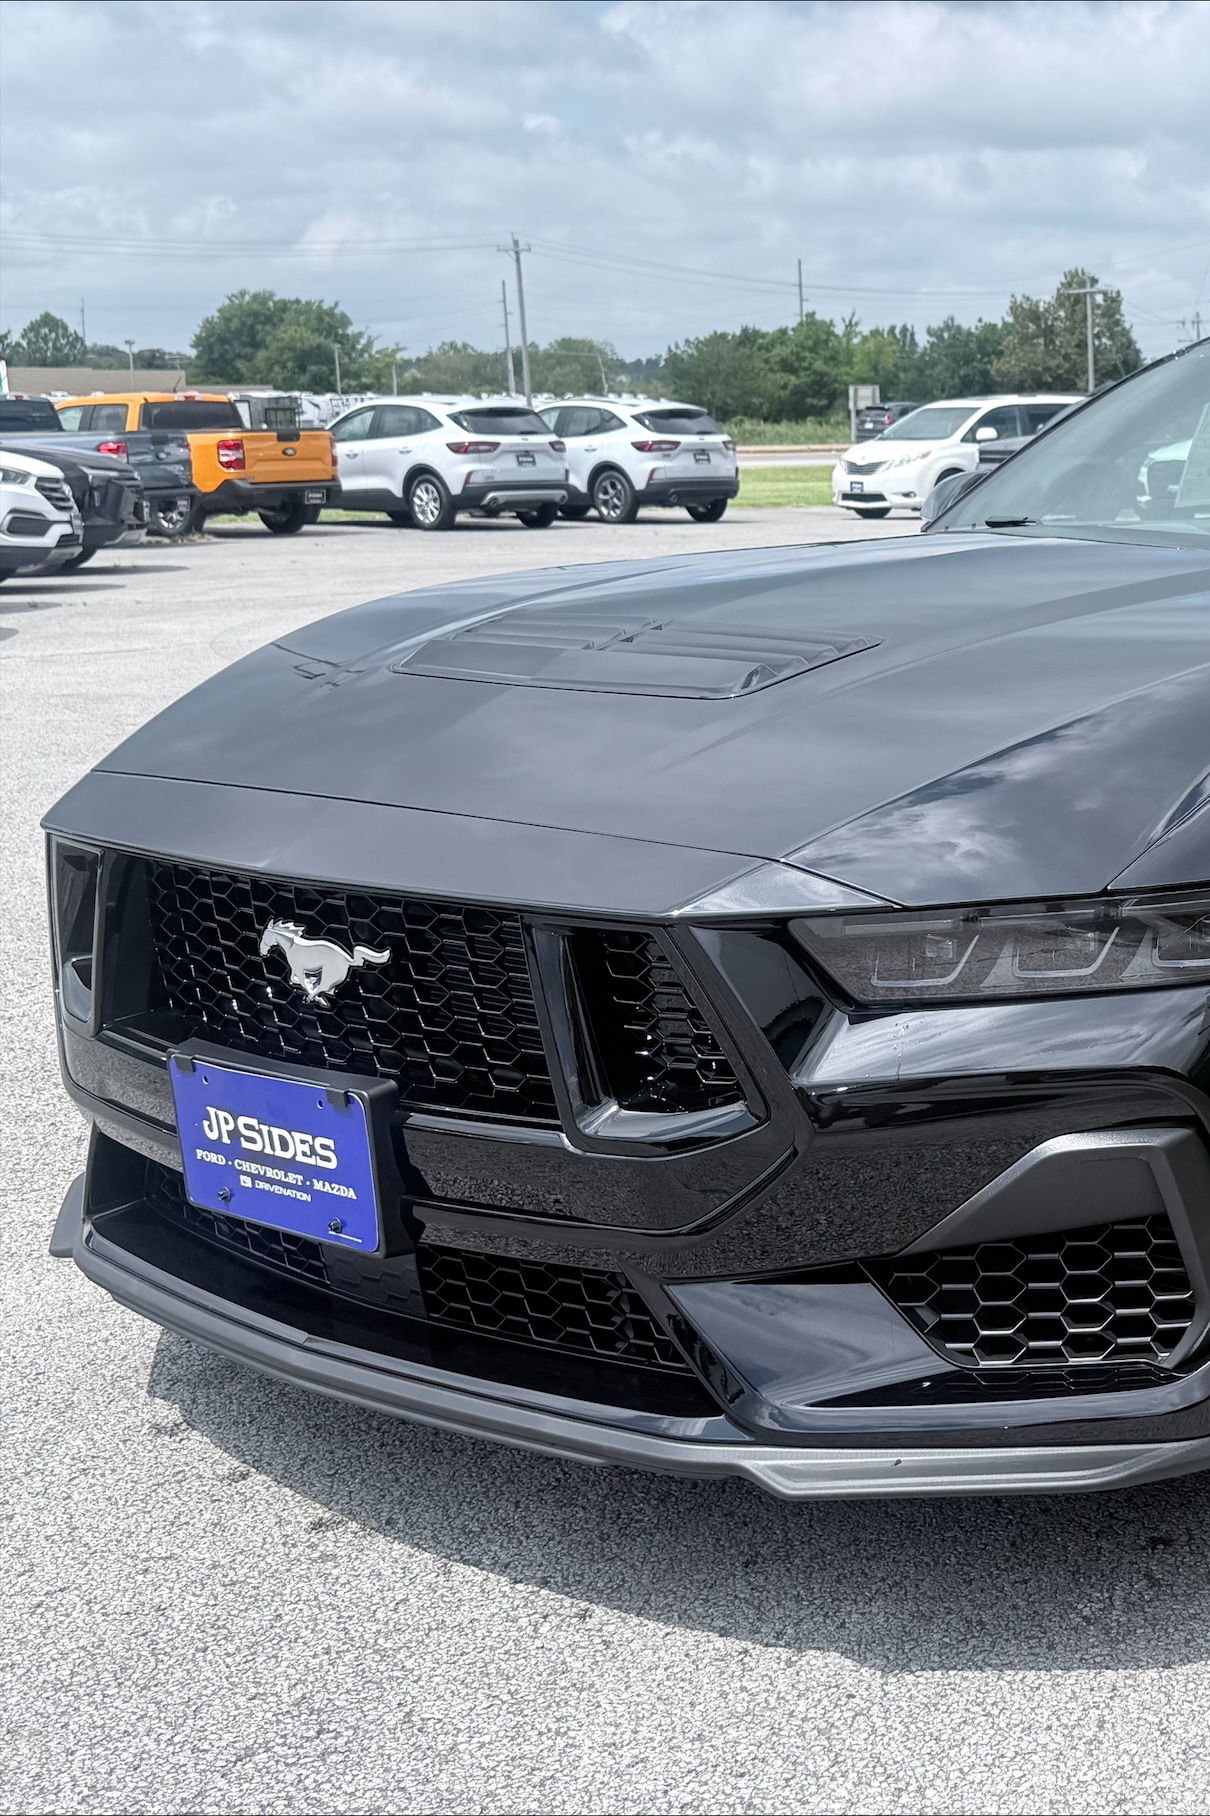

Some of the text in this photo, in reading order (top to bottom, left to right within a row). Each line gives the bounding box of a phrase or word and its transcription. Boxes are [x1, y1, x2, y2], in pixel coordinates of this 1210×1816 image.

[203, 1106, 338, 1170] JP SIDES
[195, 1149, 358, 1200] FORD CHEVROLET MAZDA
[255, 1180, 312, 1202] DRIVENATION
